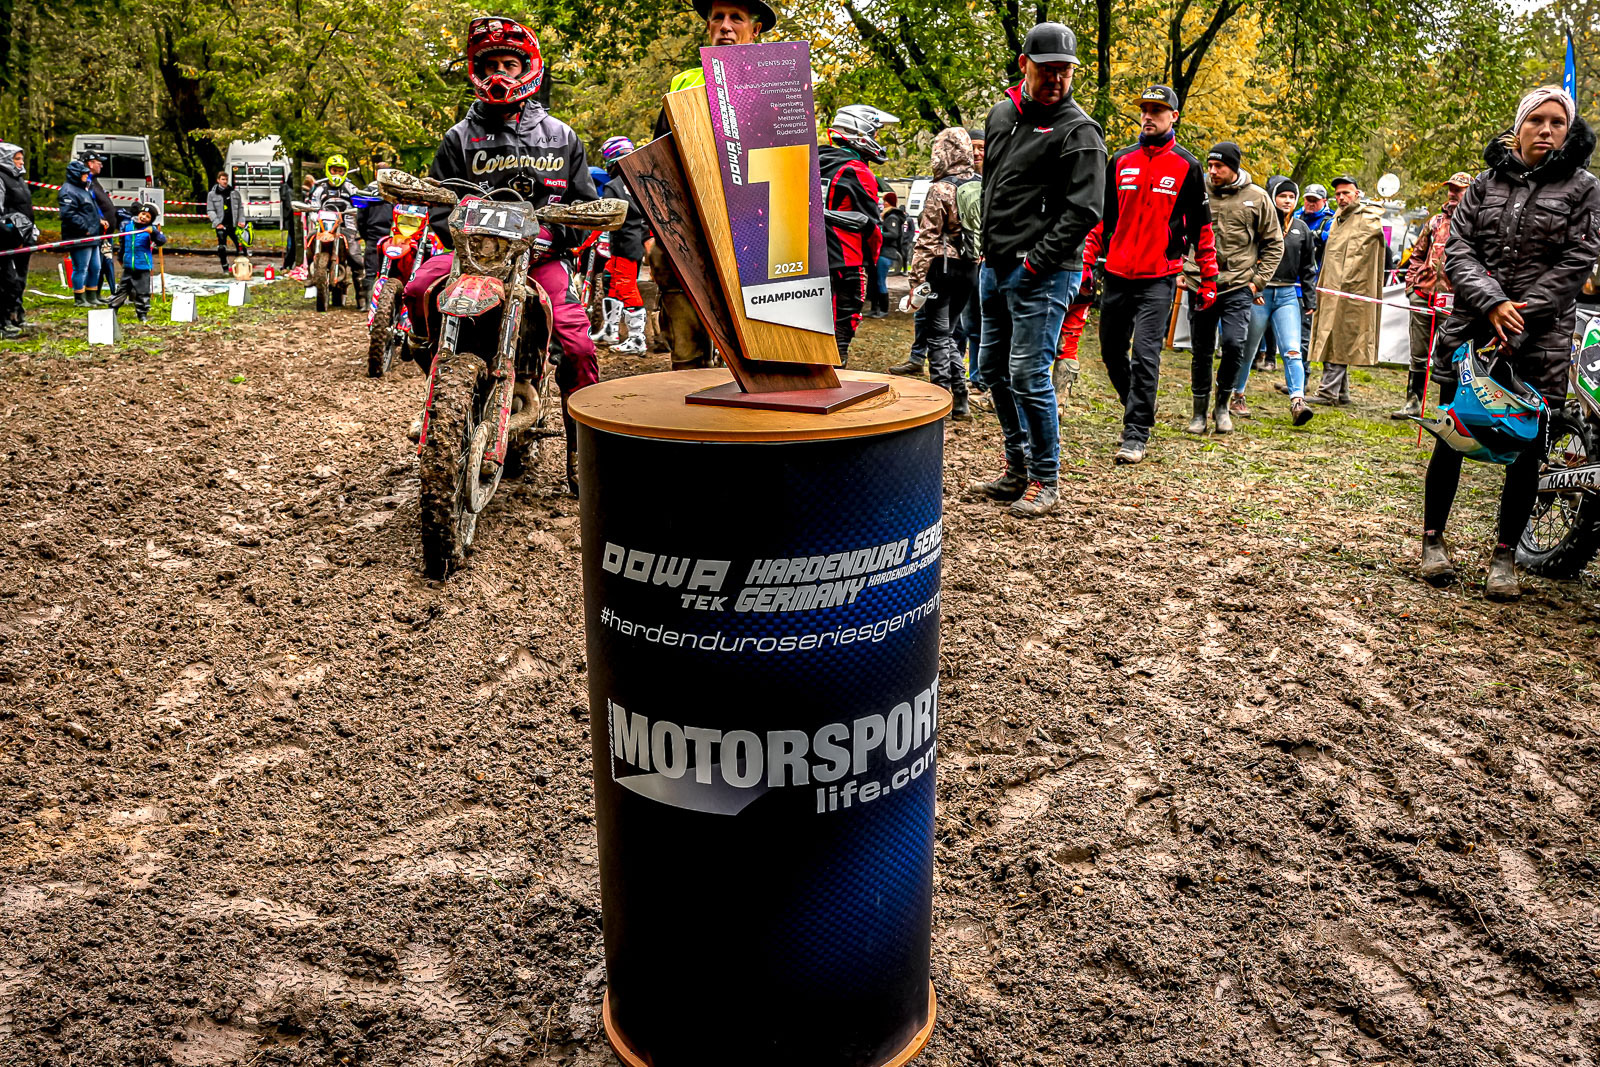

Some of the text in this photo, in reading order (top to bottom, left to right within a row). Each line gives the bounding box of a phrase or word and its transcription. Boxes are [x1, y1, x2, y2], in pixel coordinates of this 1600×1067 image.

[781, 58, 797, 66] 2023
[472, 150, 564, 175] Coremoto
[480, 208, 508, 229] 71
[748, 144, 810, 279] 1
[774, 261, 804, 275] 2023
[751, 287, 825, 305] CHAMPIONAT
[1474, 386, 1493, 408] FLY
[1548, 471, 1596, 489] MAXXIS
[602, 541, 731, 592] DOWA
[744, 538, 909, 585] HARDENDURO
[680, 593, 728, 612] TEK
[734, 576, 867, 613] GERMANY
[612, 672, 939, 788] MOTORSPORT
[816, 740, 937, 814] life.com
